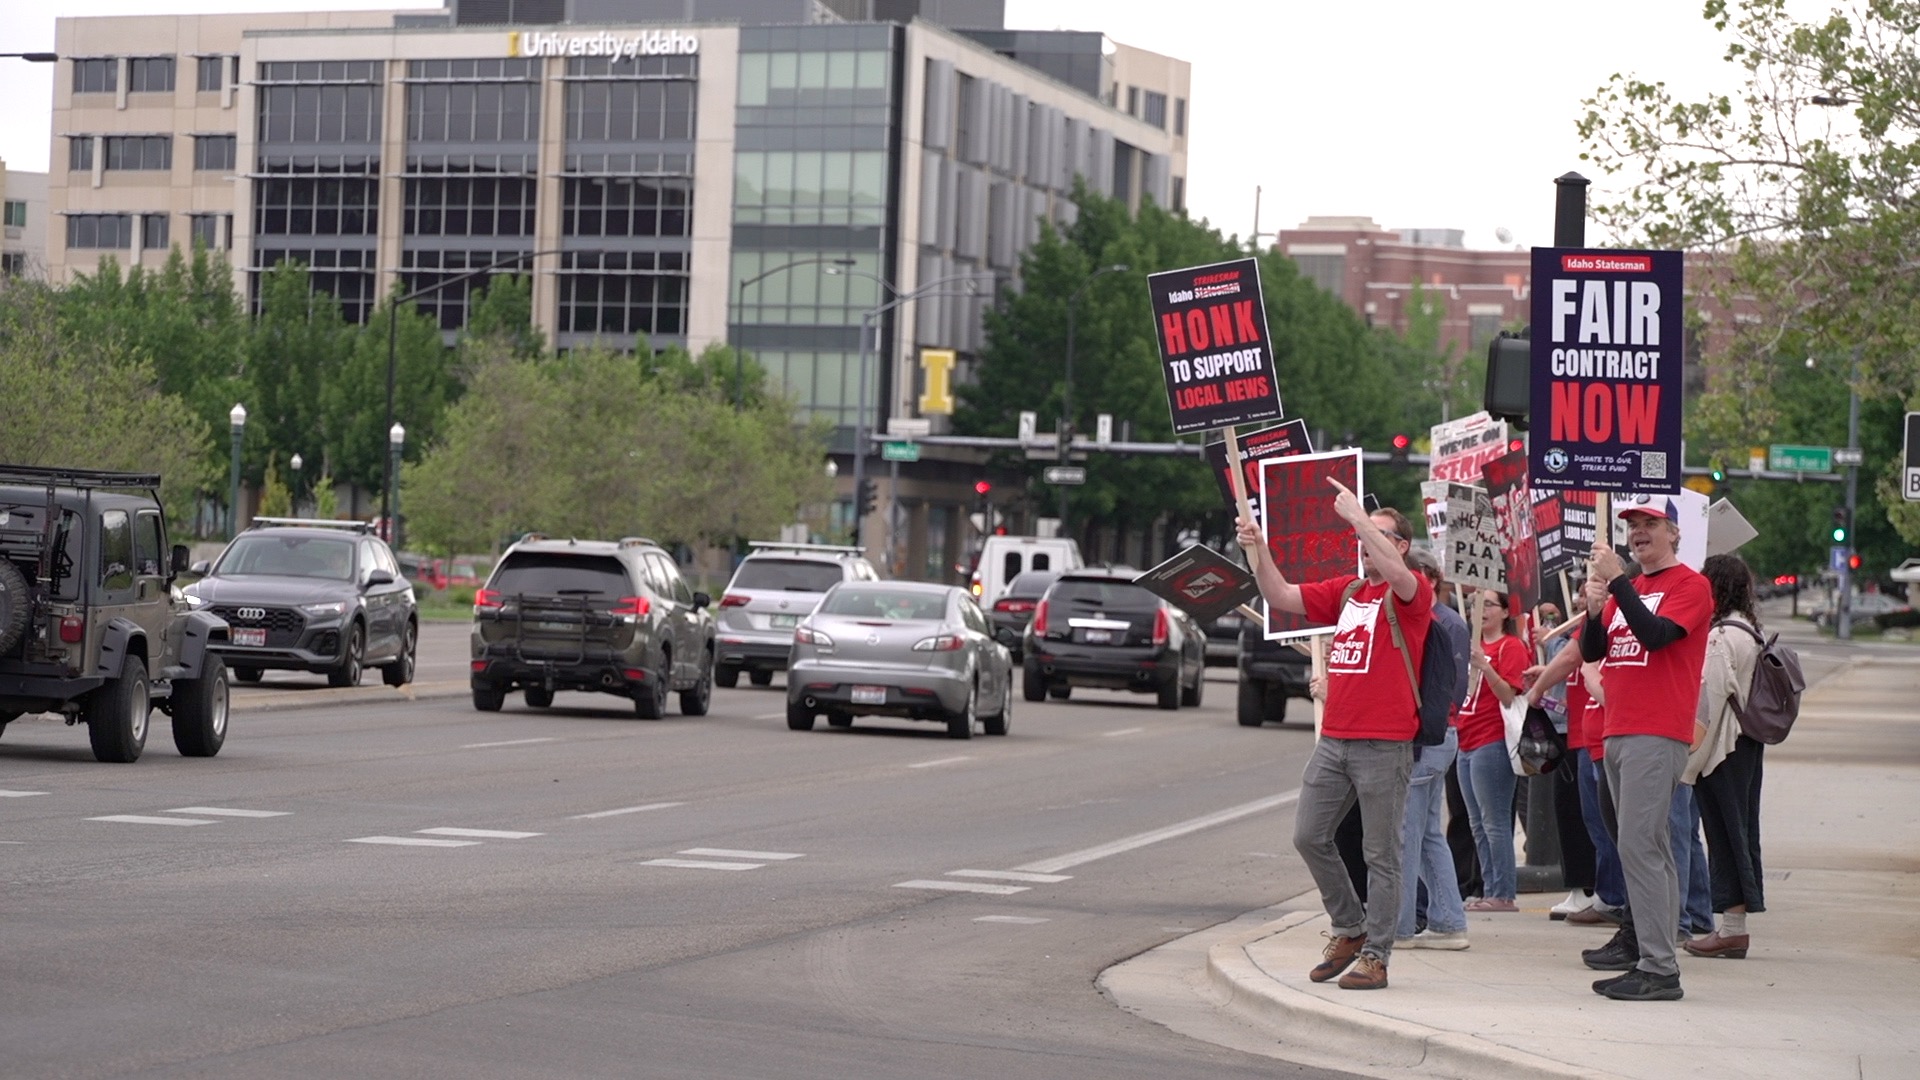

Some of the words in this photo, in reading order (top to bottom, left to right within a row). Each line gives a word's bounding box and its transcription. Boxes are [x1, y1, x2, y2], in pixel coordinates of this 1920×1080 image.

[524, 31, 623, 63] University
[625, 38, 640, 59] of
[642, 30, 699, 55] Idaho
[1567, 258, 1594, 269] Idaho
[1595, 259, 1645, 270] Statesman
[1168, 289, 1194, 304] Idaho
[1552, 279, 1661, 345] FAIR
[1162, 300, 1259, 355] HONK
[1170, 359, 1192, 383] TO
[1193, 347, 1262, 380] SUPPORT
[1551, 348, 1660, 379] CONTRACT
[918, 350, 955, 415] I
[1176, 384, 1223, 410] LOCAL
[1225, 376, 1269, 402] NEWS
[1551, 381, 1660, 445] NOW
[1440, 434, 1478, 457] WE'RE
[1482, 426, 1500, 443] ON
[1574, 455, 1602, 463] DONATE
[1581, 464, 1607, 472] STRIKE
[1609, 464, 1628, 472] FUND
[1458, 511, 1483, 531] HEY
[1456, 541, 1493, 560] PLA
[1610, 642, 1641, 658] GUILD
